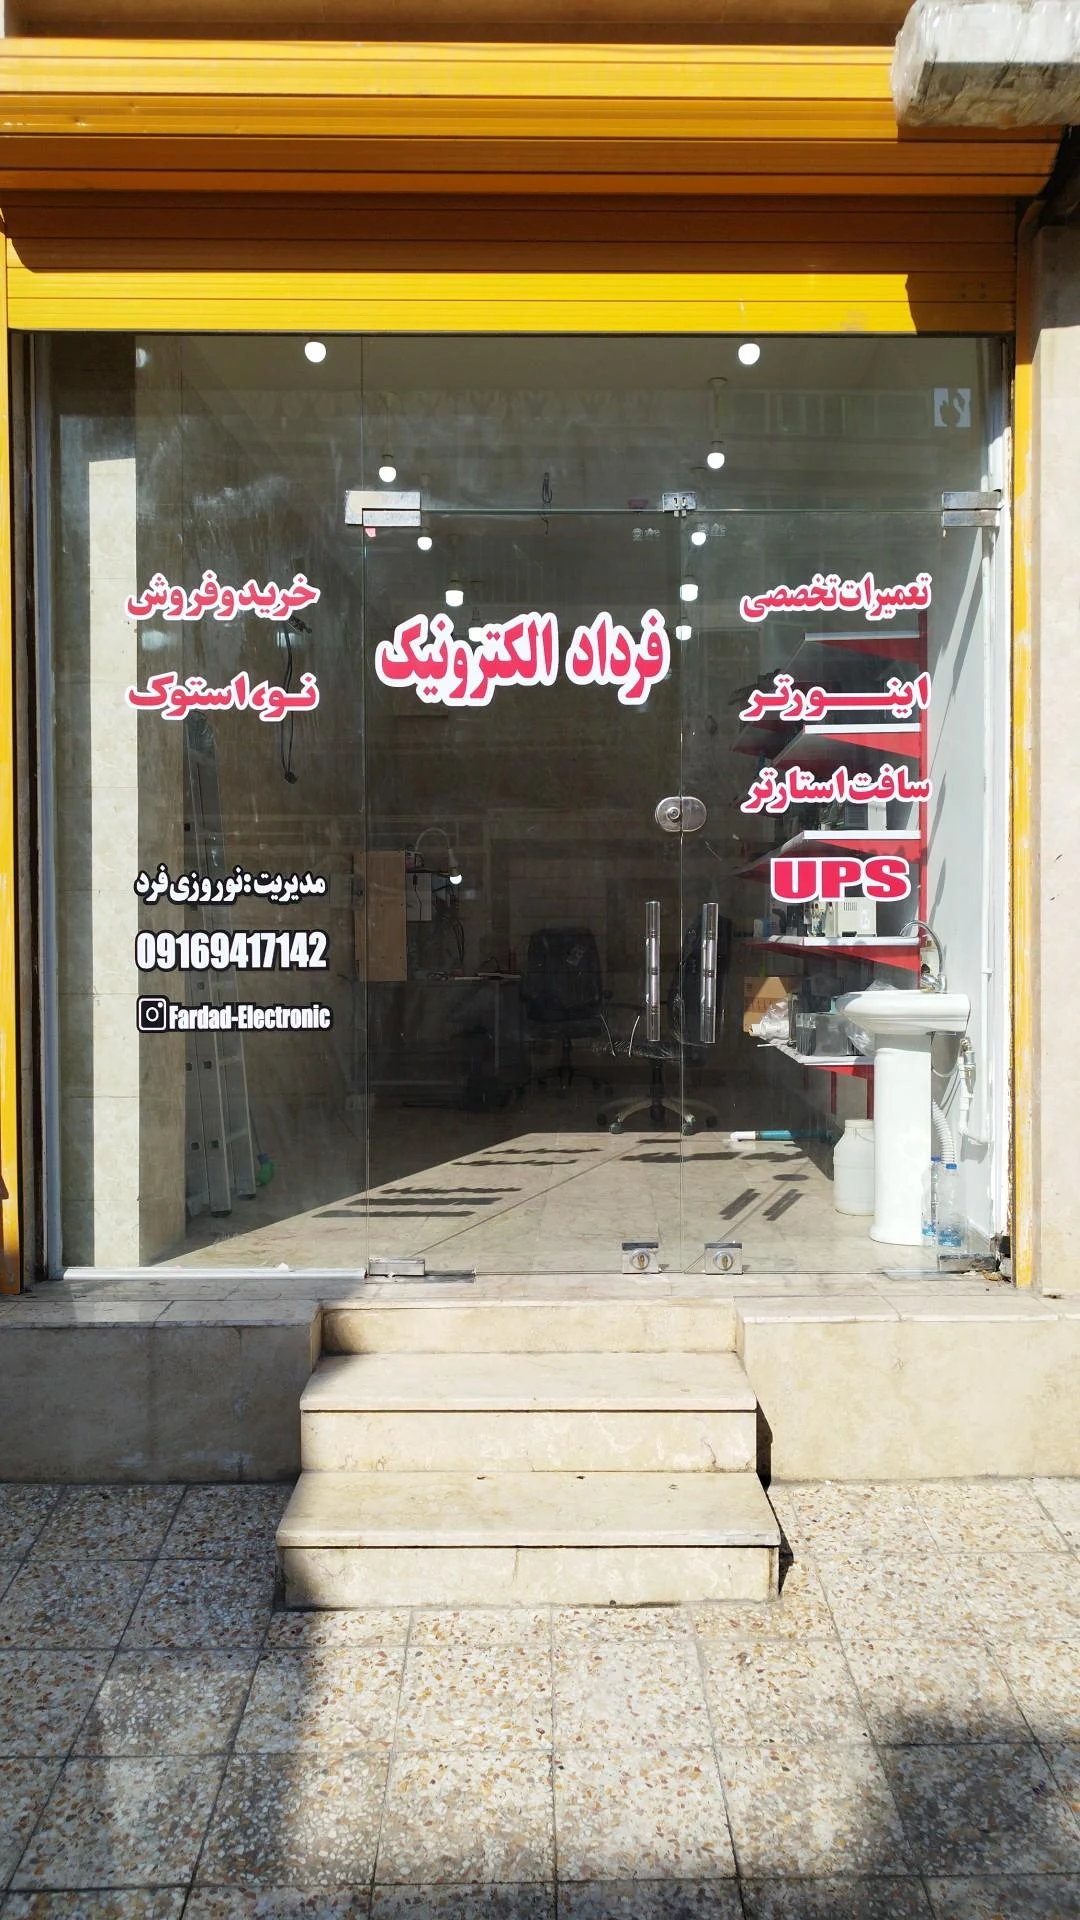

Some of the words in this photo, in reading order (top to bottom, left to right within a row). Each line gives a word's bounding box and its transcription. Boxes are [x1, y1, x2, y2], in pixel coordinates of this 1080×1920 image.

[126, 571, 219, 618] فروش
[238, 574, 319, 618] خرید
[742, 575, 837, 619] تخصصی
[838, 574, 930, 618] تعمیرات
[378, 615, 556, 703] الکترونیک
[567, 611, 667, 702] فرداد
[743, 768, 846, 811] استارتر
[848, 765, 931, 802] سافت
[772, 857, 910, 902] UPS
[135, 931, 328, 970] 09169417142
[168, 1004, 331, 1030] Fardad-Electronic
